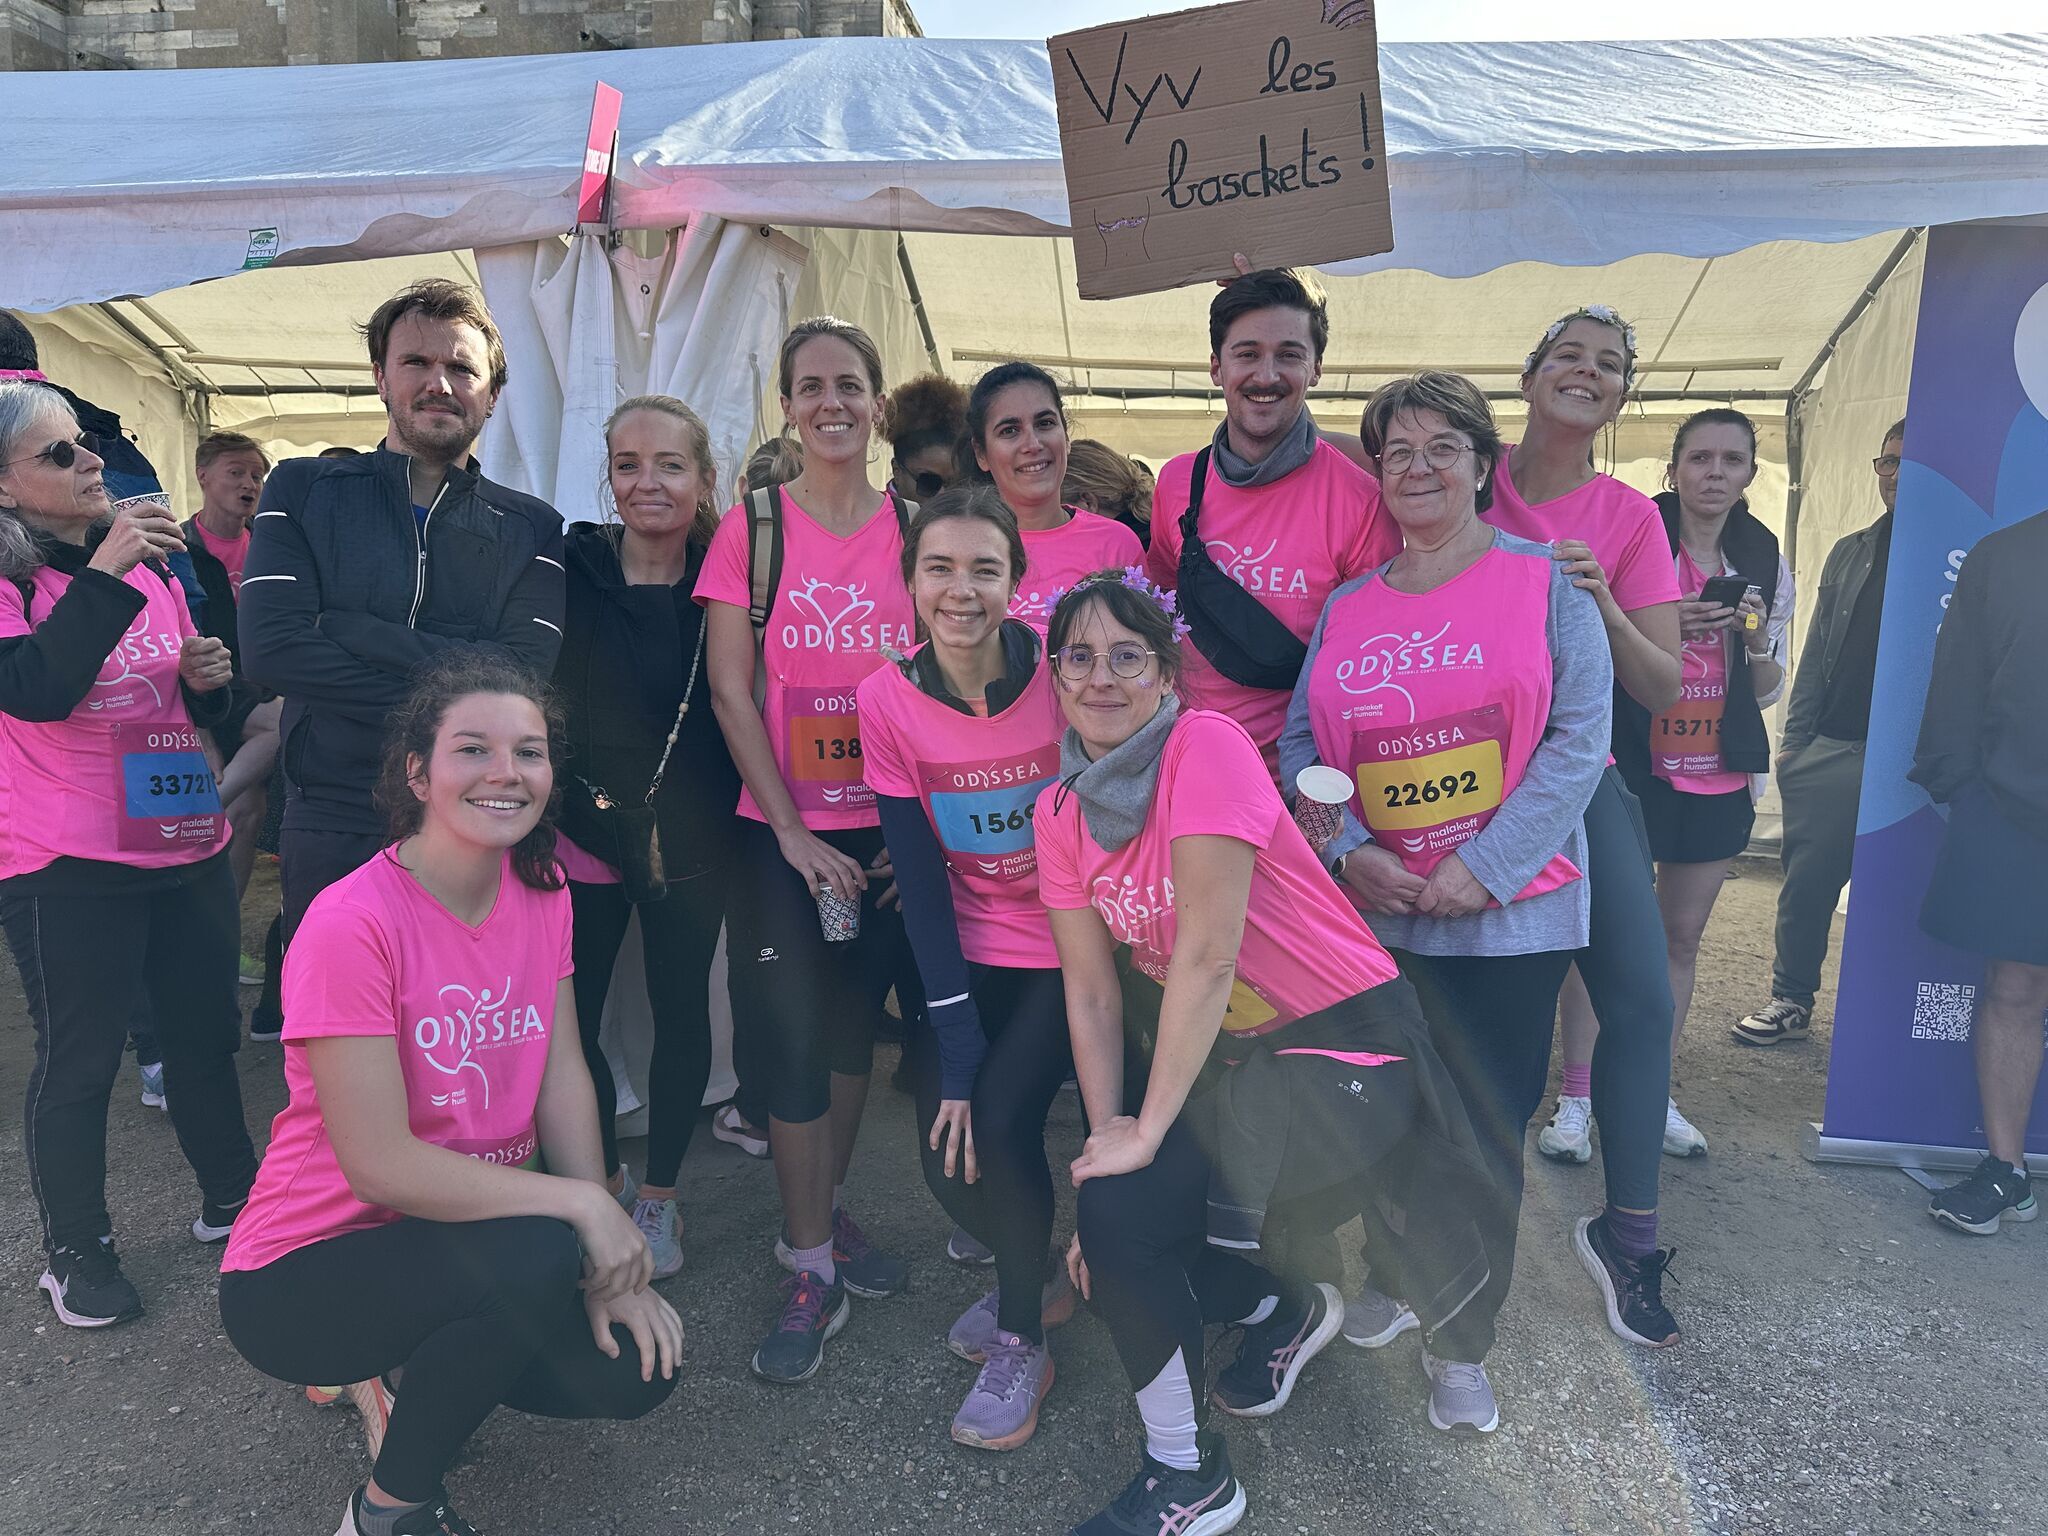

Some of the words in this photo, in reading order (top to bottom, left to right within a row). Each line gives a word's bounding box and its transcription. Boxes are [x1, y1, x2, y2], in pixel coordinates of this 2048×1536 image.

[1066, 32, 1201, 144] Vyv
[1260, 36, 1337, 94] les
[782, 623, 911, 653] ODYSSEA
[1336, 642, 1484, 681] ODYSSEA
[814, 689, 857, 714] ODYS
[1378, 726, 1465, 756] ODYSSEA
[953, 762, 1041, 788] ODYSSEA
[1683, 762, 1719, 771] humanis
[1384, 770, 1479, 808] 22692
[180, 827, 216, 838] humanis
[1428, 817, 1478, 840] malakoff
[1430, 829, 1480, 849] humanis
